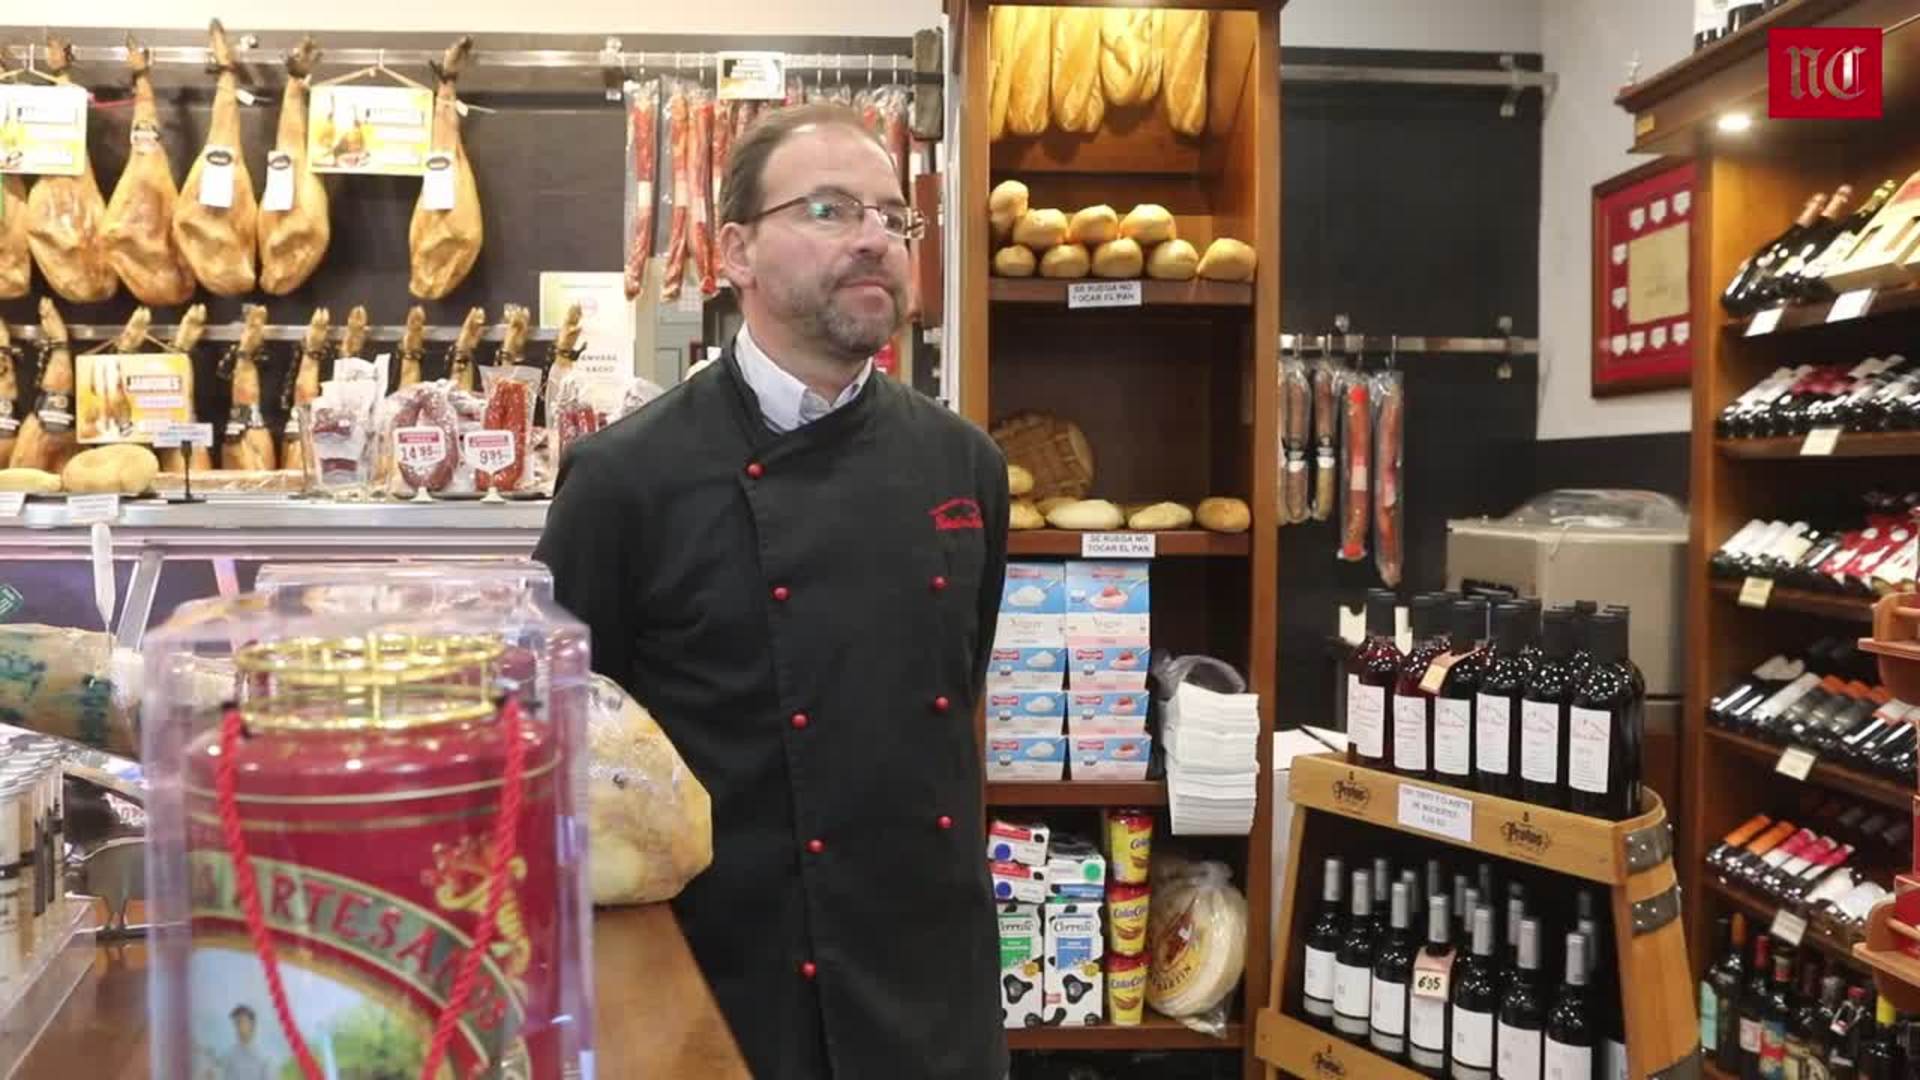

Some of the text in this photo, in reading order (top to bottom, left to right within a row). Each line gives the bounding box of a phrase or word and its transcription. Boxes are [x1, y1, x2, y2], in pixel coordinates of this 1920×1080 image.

[1087, 543, 1150, 553] TOCAR EL PAN
